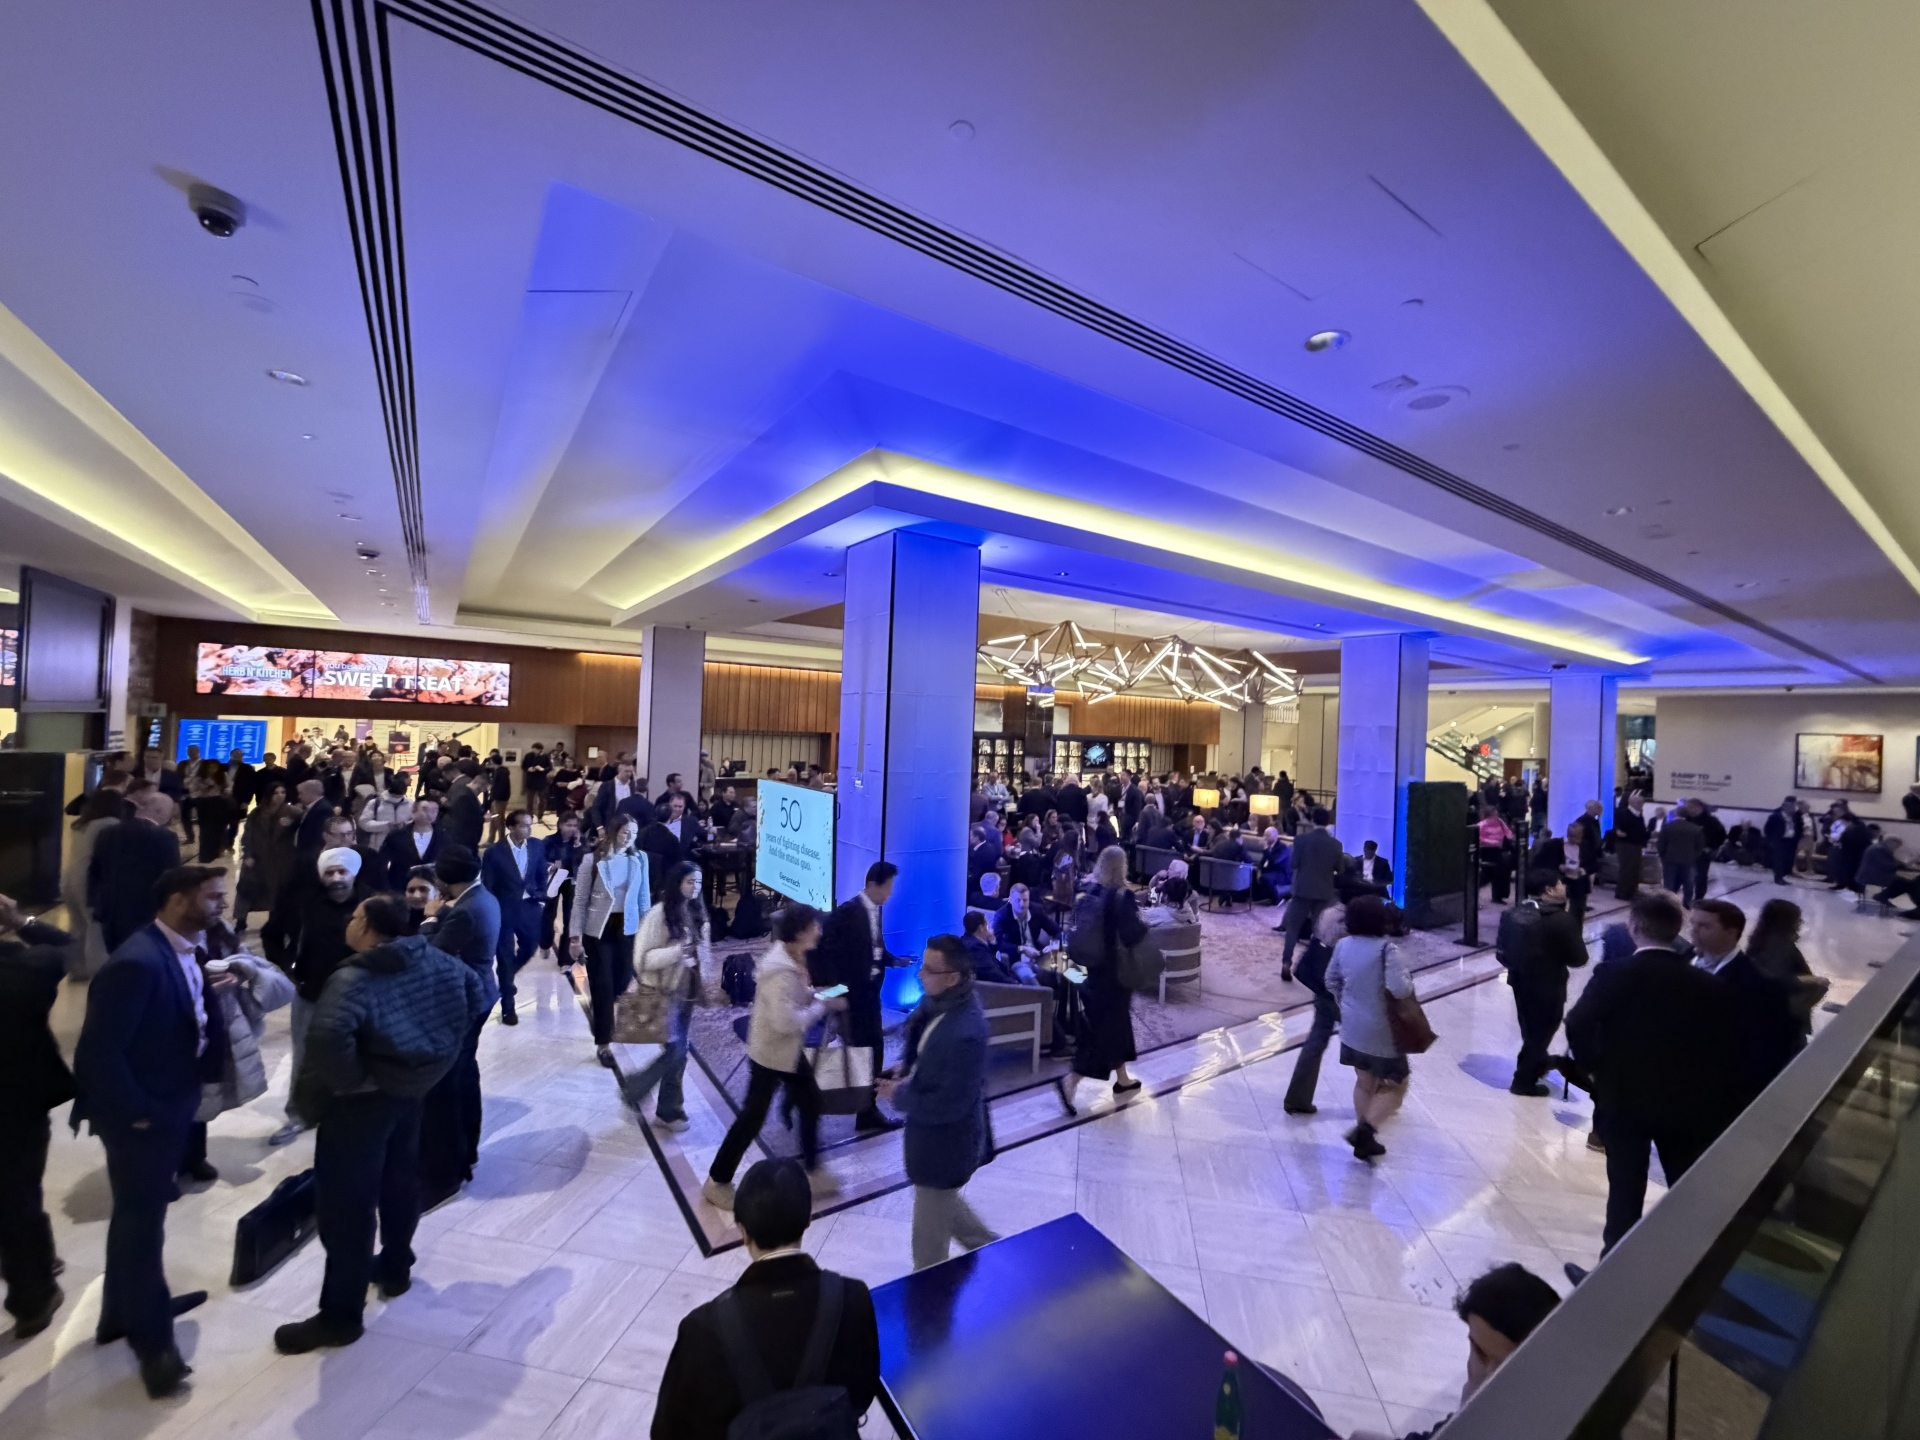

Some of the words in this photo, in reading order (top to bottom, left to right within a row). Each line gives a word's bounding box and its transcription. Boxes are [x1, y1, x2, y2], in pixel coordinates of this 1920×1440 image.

[222, 666, 246, 677] HERB
[257, 668, 292, 680] KITCHEN
[324, 671, 396, 689] SWEET
[402, 675, 463, 691] TREAT
[780, 797, 802, 832] 50
[766, 833, 777, 843] years
[783, 836, 800, 855] fighting
[801, 843, 821, 860] disease.
[769, 844, 778, 856] And
[778, 848, 786, 861] the
[786, 854, 800, 867] status
[779, 871, 801, 888] Genentech
